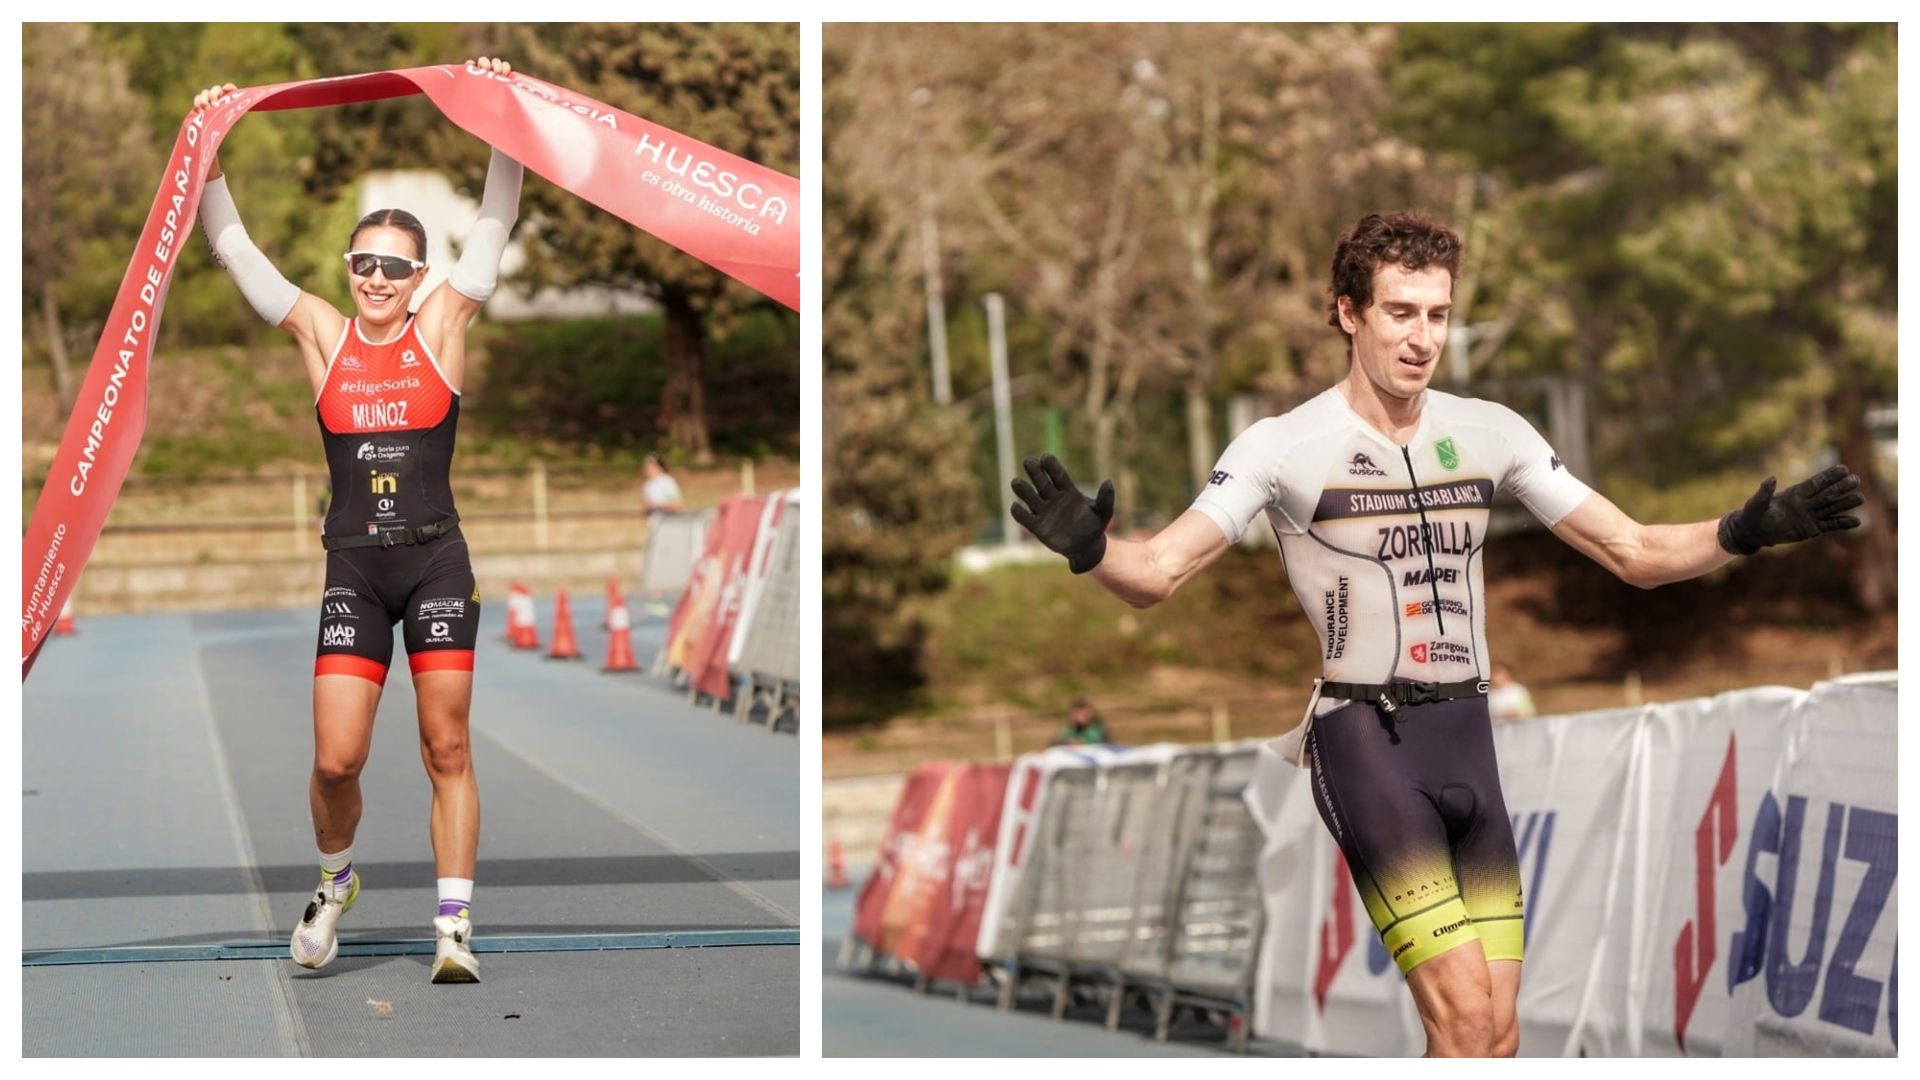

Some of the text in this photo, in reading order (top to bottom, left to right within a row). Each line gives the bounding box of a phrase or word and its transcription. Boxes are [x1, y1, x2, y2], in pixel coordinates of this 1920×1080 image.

[634, 133, 787, 226] HUESCA
[641, 168, 761, 237] es otra historia
[69, 309, 147, 498] CAMPEONATO
[142, 271, 162, 306] DE
[155, 154, 192, 267] ESPAÑA
[340, 376, 420, 397] #eligeSoria
[352, 399, 408, 428] MUÑOZ
[1350, 493, 1408, 512] STADIUM
[1377, 521, 1472, 562] ZORRILLA
[22, 523, 67, 632] Ayuntamiento
[31, 562, 66, 642] de Huesca
[1403, 567, 1458, 587] MAPEI
[324, 623, 355, 639] MAD
[1326, 590, 1335, 660] ENDURANCE
[1334, 576, 1349, 658] DEVELOPMENT
[1430, 641, 1469, 653] Zaragoza
[1727, 789, 1898, 1050] SUZ
